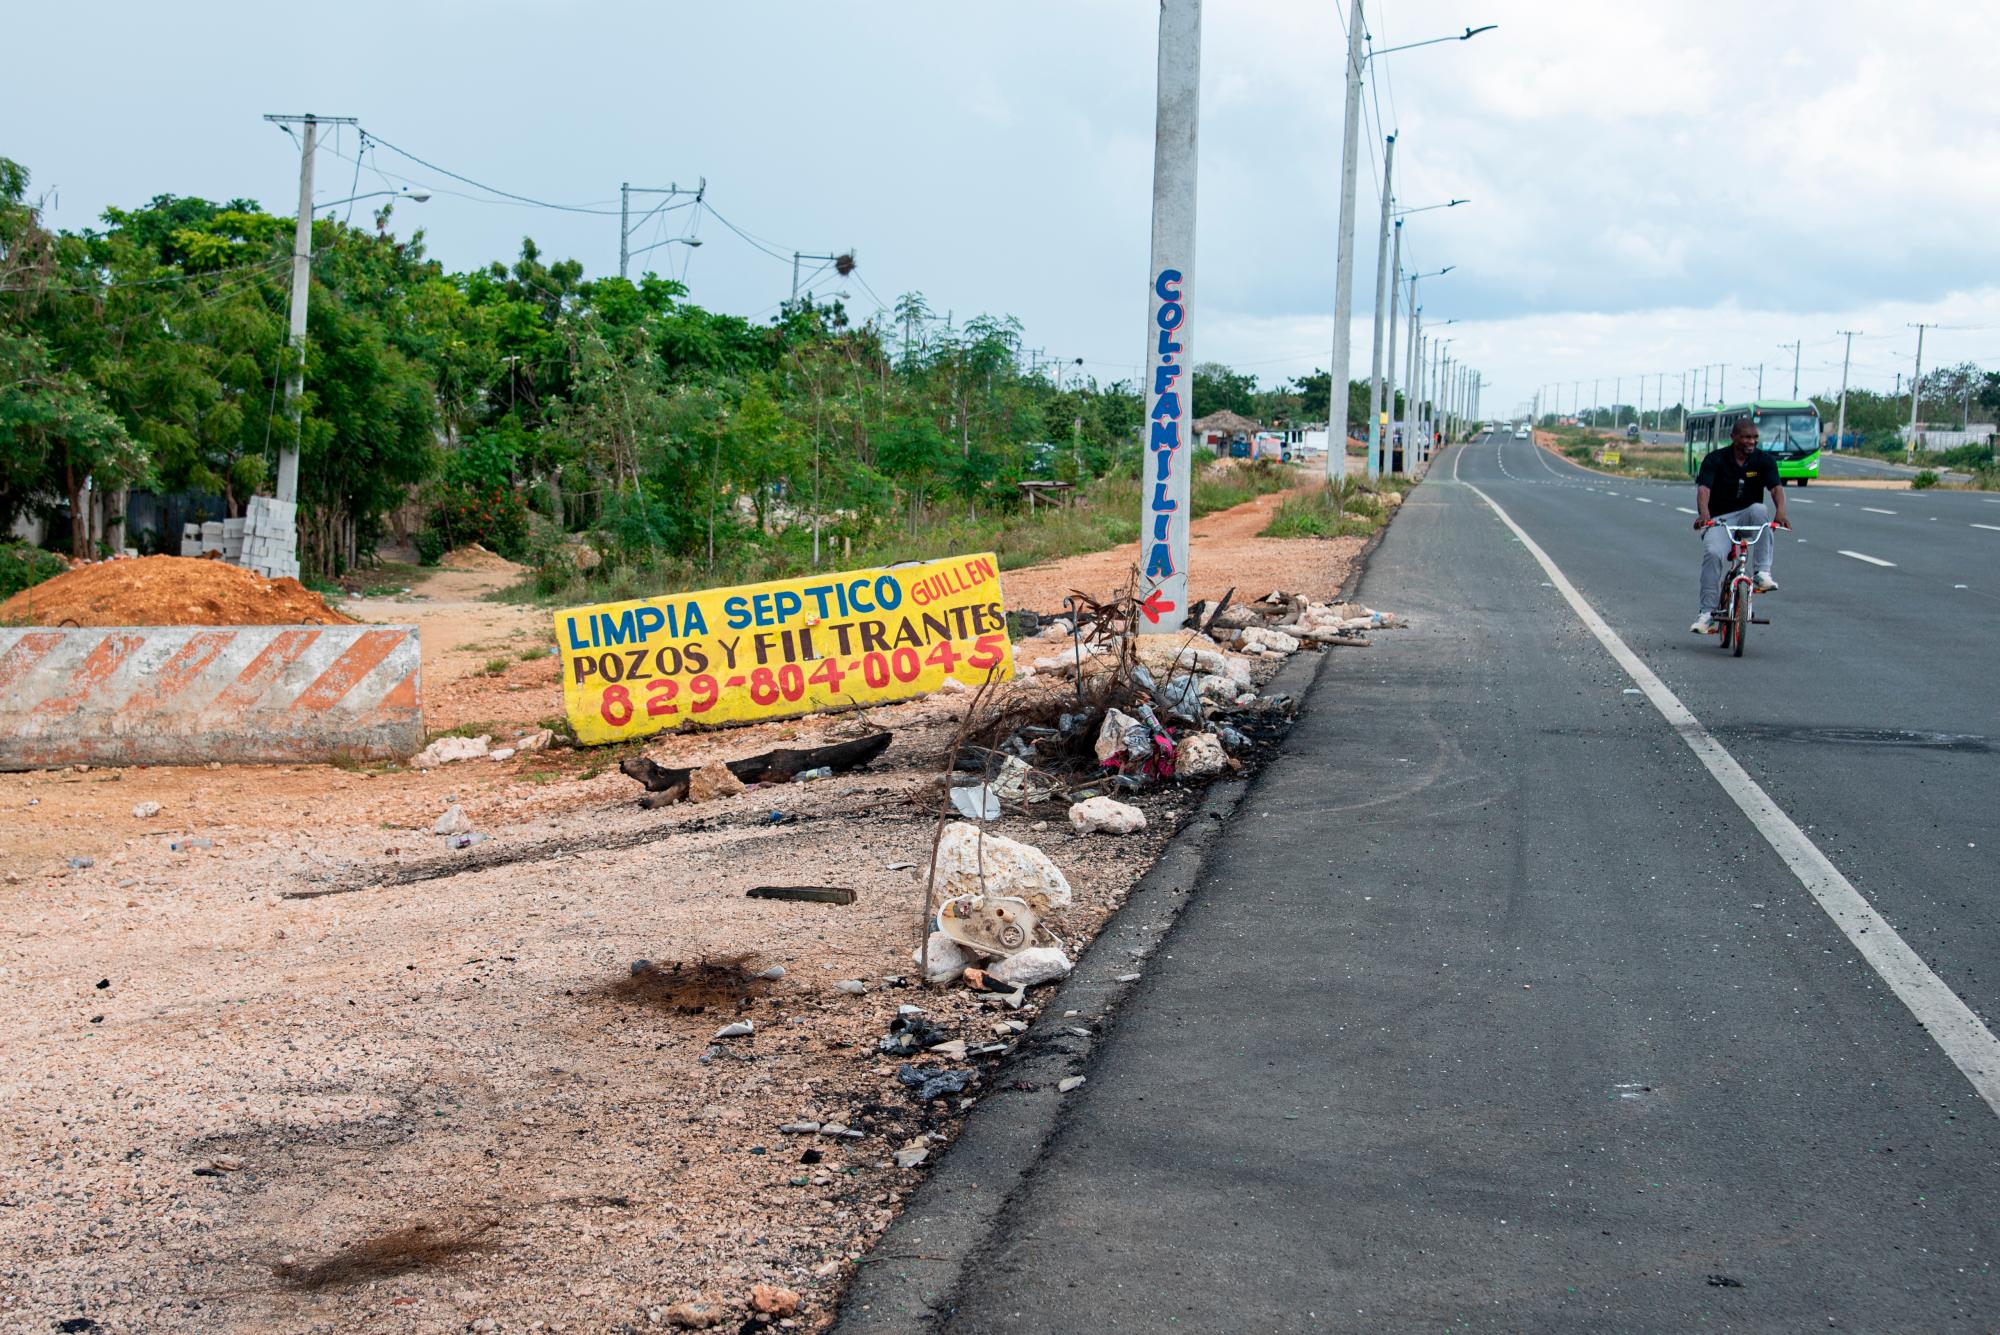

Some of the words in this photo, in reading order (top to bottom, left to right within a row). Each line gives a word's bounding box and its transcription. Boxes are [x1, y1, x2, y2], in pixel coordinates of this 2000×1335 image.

[567, 601, 708, 650] LIMPIA
[724, 575, 902, 630] SEPTICO
[911, 557, 995, 606] GUILLEN
[573, 642, 709, 685] POZOS
[718, 636, 741, 669] Y
[600, 634, 1005, 726] 829-804-0045
